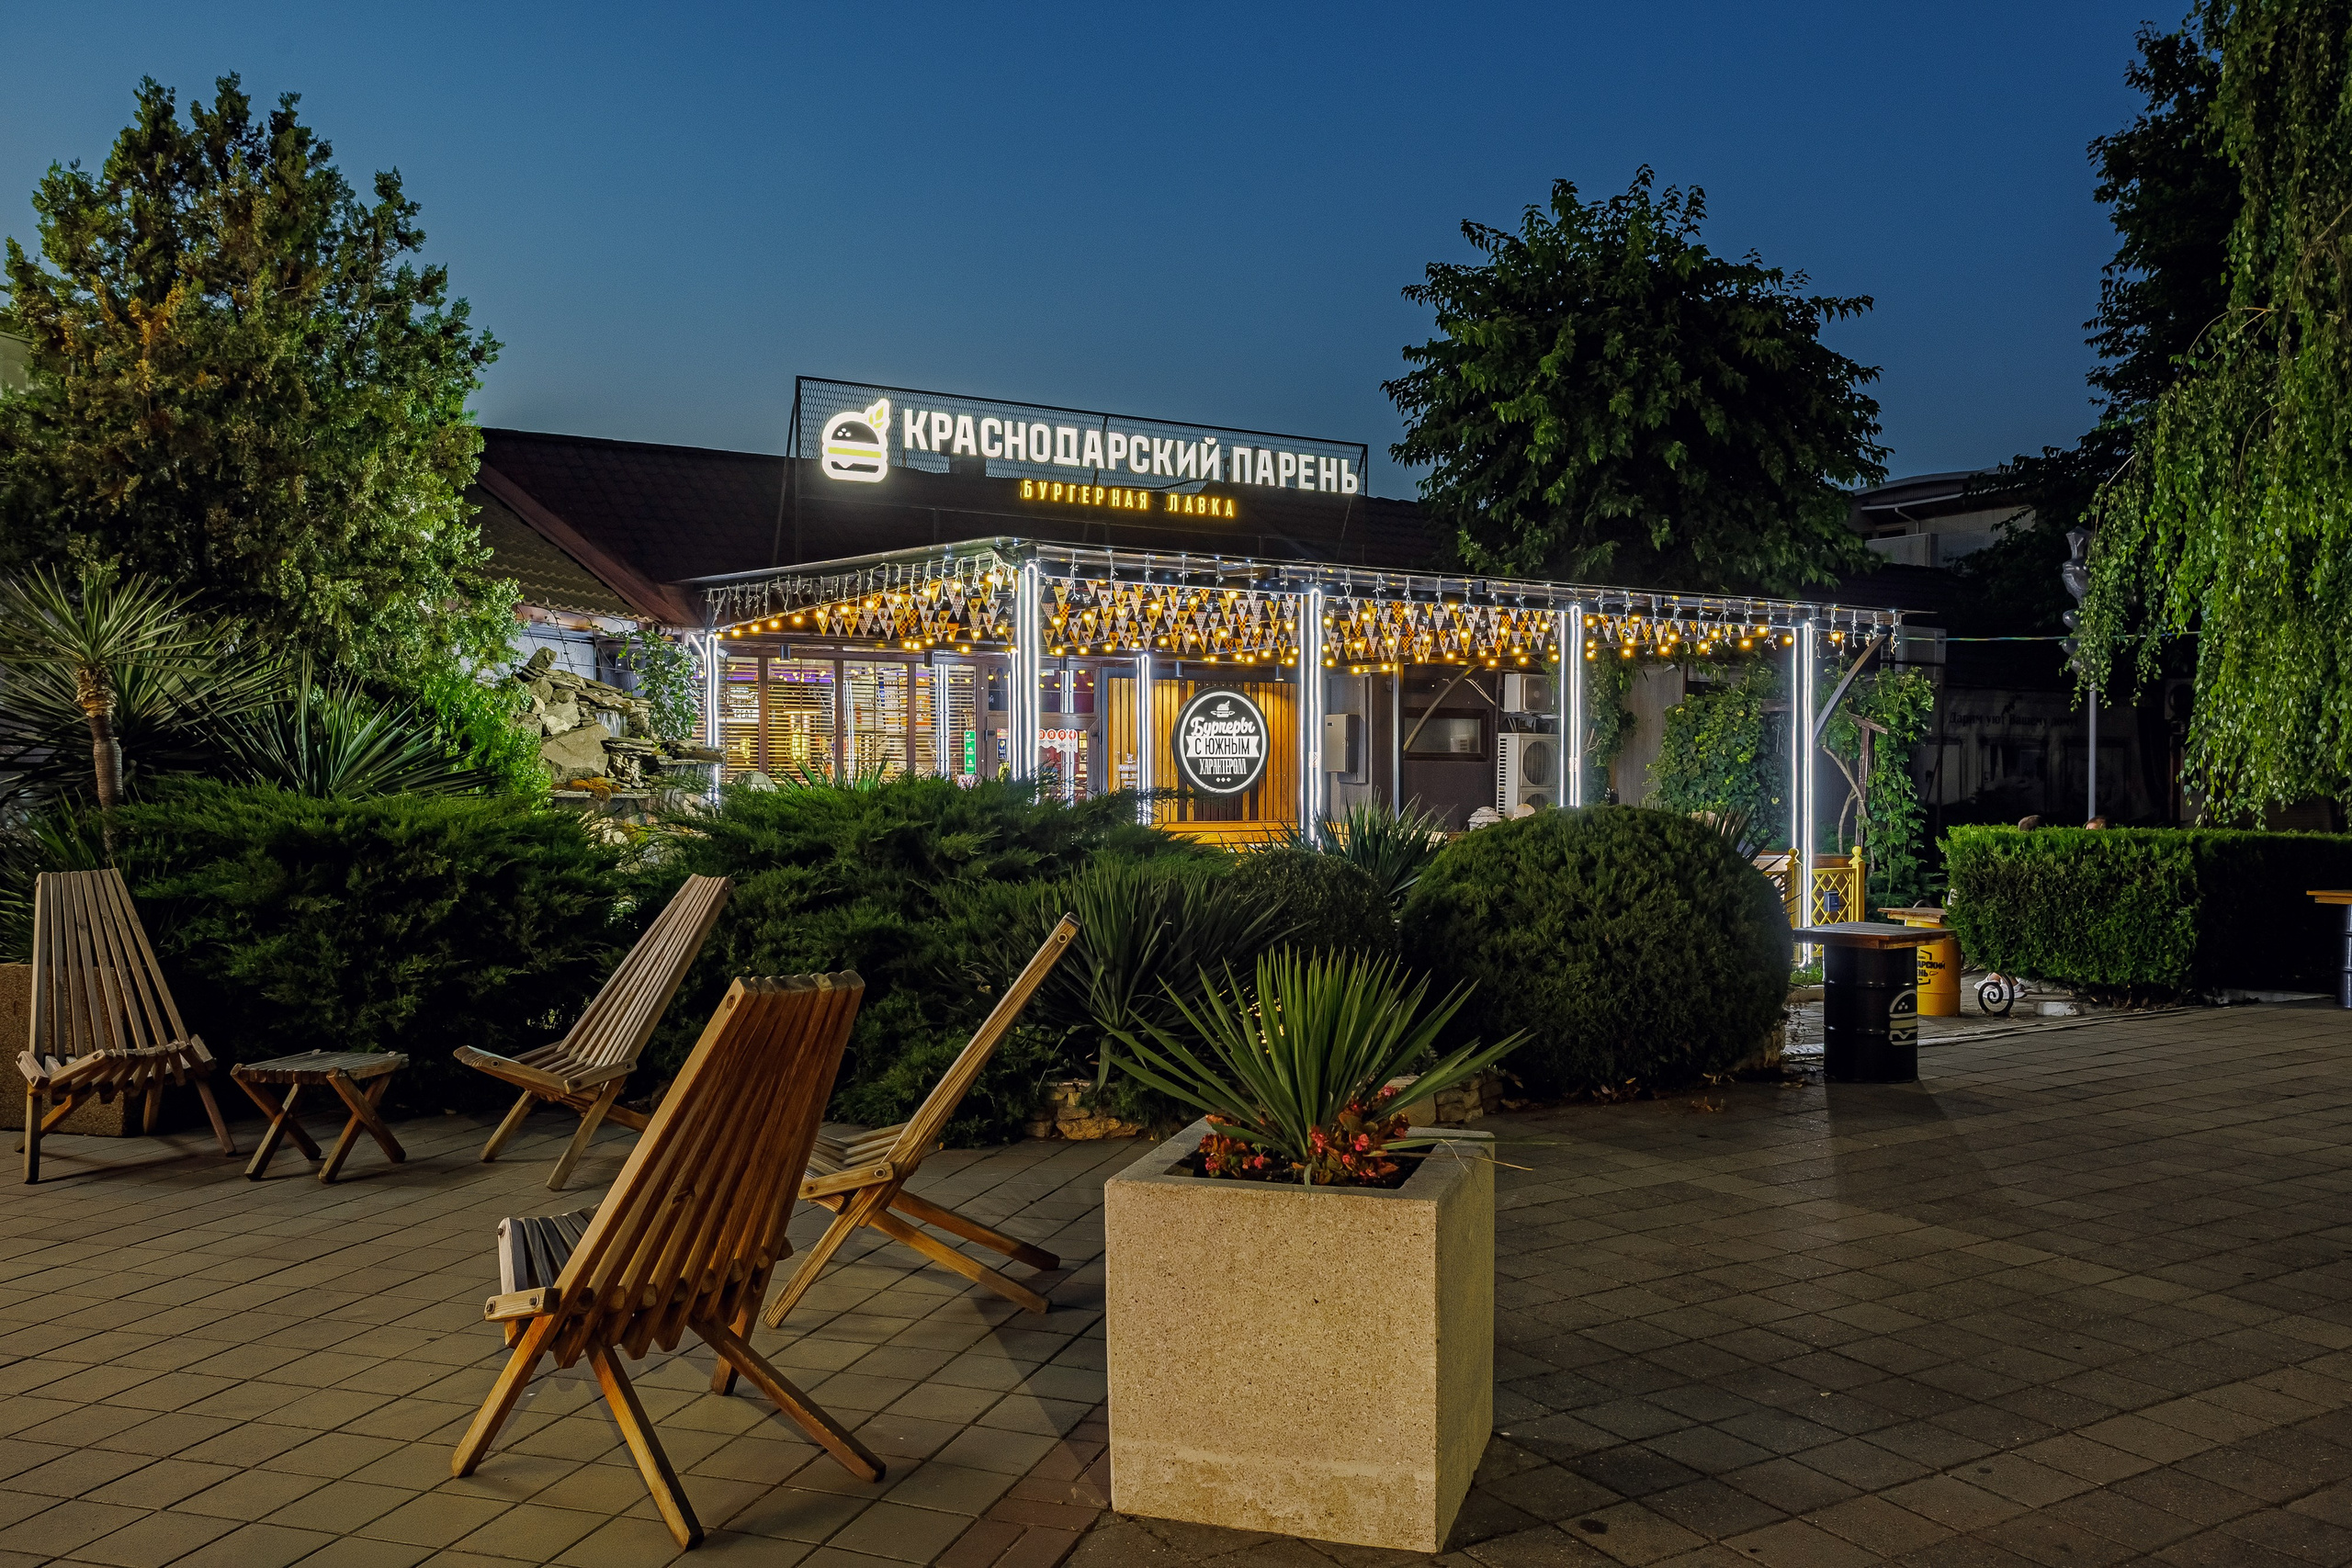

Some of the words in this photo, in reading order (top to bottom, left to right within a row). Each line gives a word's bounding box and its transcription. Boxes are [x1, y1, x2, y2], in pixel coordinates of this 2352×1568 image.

[903, 408, 1220, 481] КРАСНОДАРСКИЙ
[1231, 446, 1358, 494] ПАРЕНЬ
[1021, 479, 1148, 510] БУРГЕРНАЯ
[1169, 494, 1234, 517] ЛАВКА
[1190, 716, 1256, 738] Бургеры
[1949, 711, 1982, 726] Дарим
[1986, 715, 2005, 727] уют
[2009, 714, 2047, 728] Вашему
[1205, 738, 1250, 755] ЮЖНЫМ
[1199, 758, 1247, 775] ХАРАКТЕРОМ
